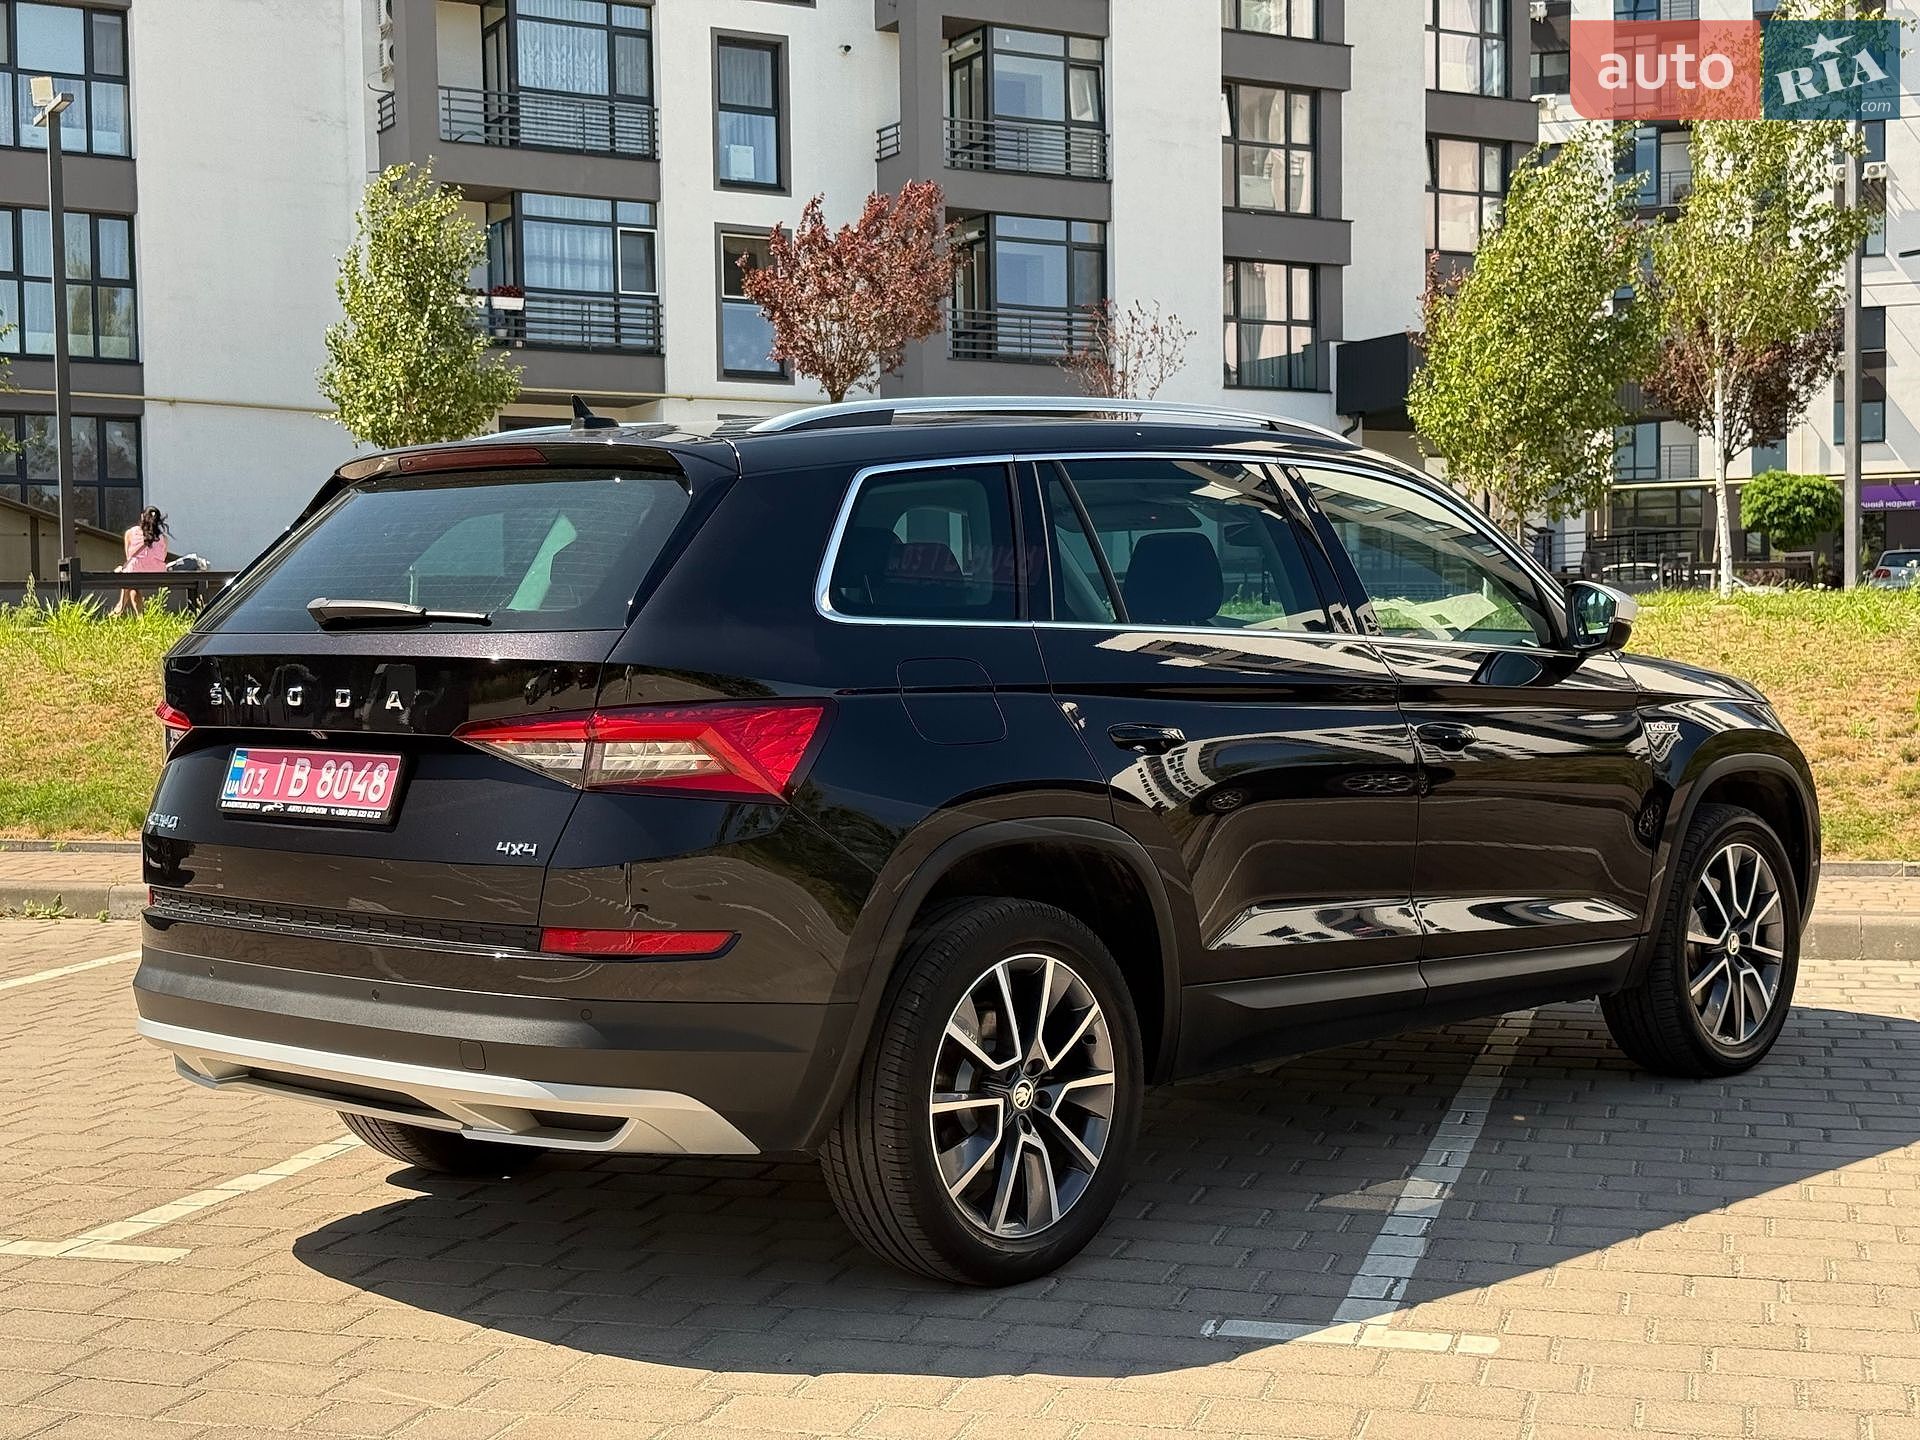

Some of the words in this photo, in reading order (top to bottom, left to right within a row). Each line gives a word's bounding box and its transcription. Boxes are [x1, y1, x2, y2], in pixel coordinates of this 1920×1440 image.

[210, 682, 404, 710] ŠKODA
[226, 780, 240, 794] UA
[240, 768, 270, 796] 03
[316, 759, 389, 803] 8048
